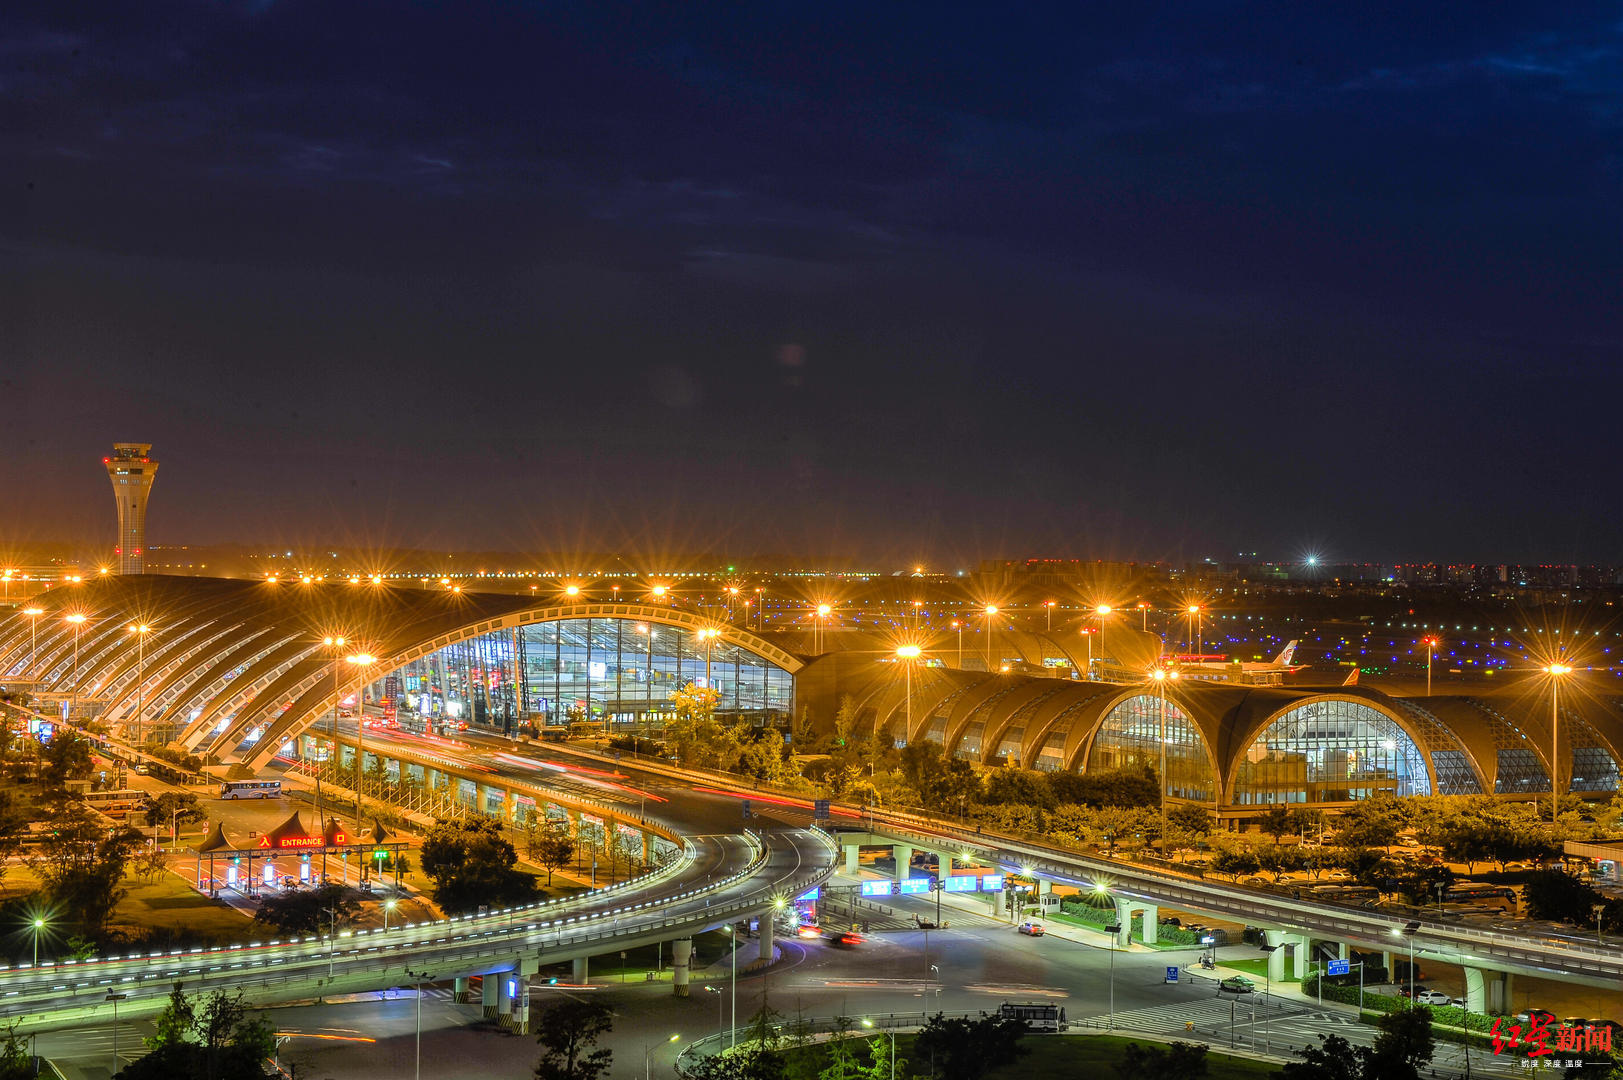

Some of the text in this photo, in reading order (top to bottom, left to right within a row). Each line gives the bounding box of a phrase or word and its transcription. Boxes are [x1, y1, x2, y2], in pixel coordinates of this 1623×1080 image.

[260, 836, 271, 847] 入
[281, 837, 322, 847] ENTRANCE
[374, 851, 388, 859] ETC
